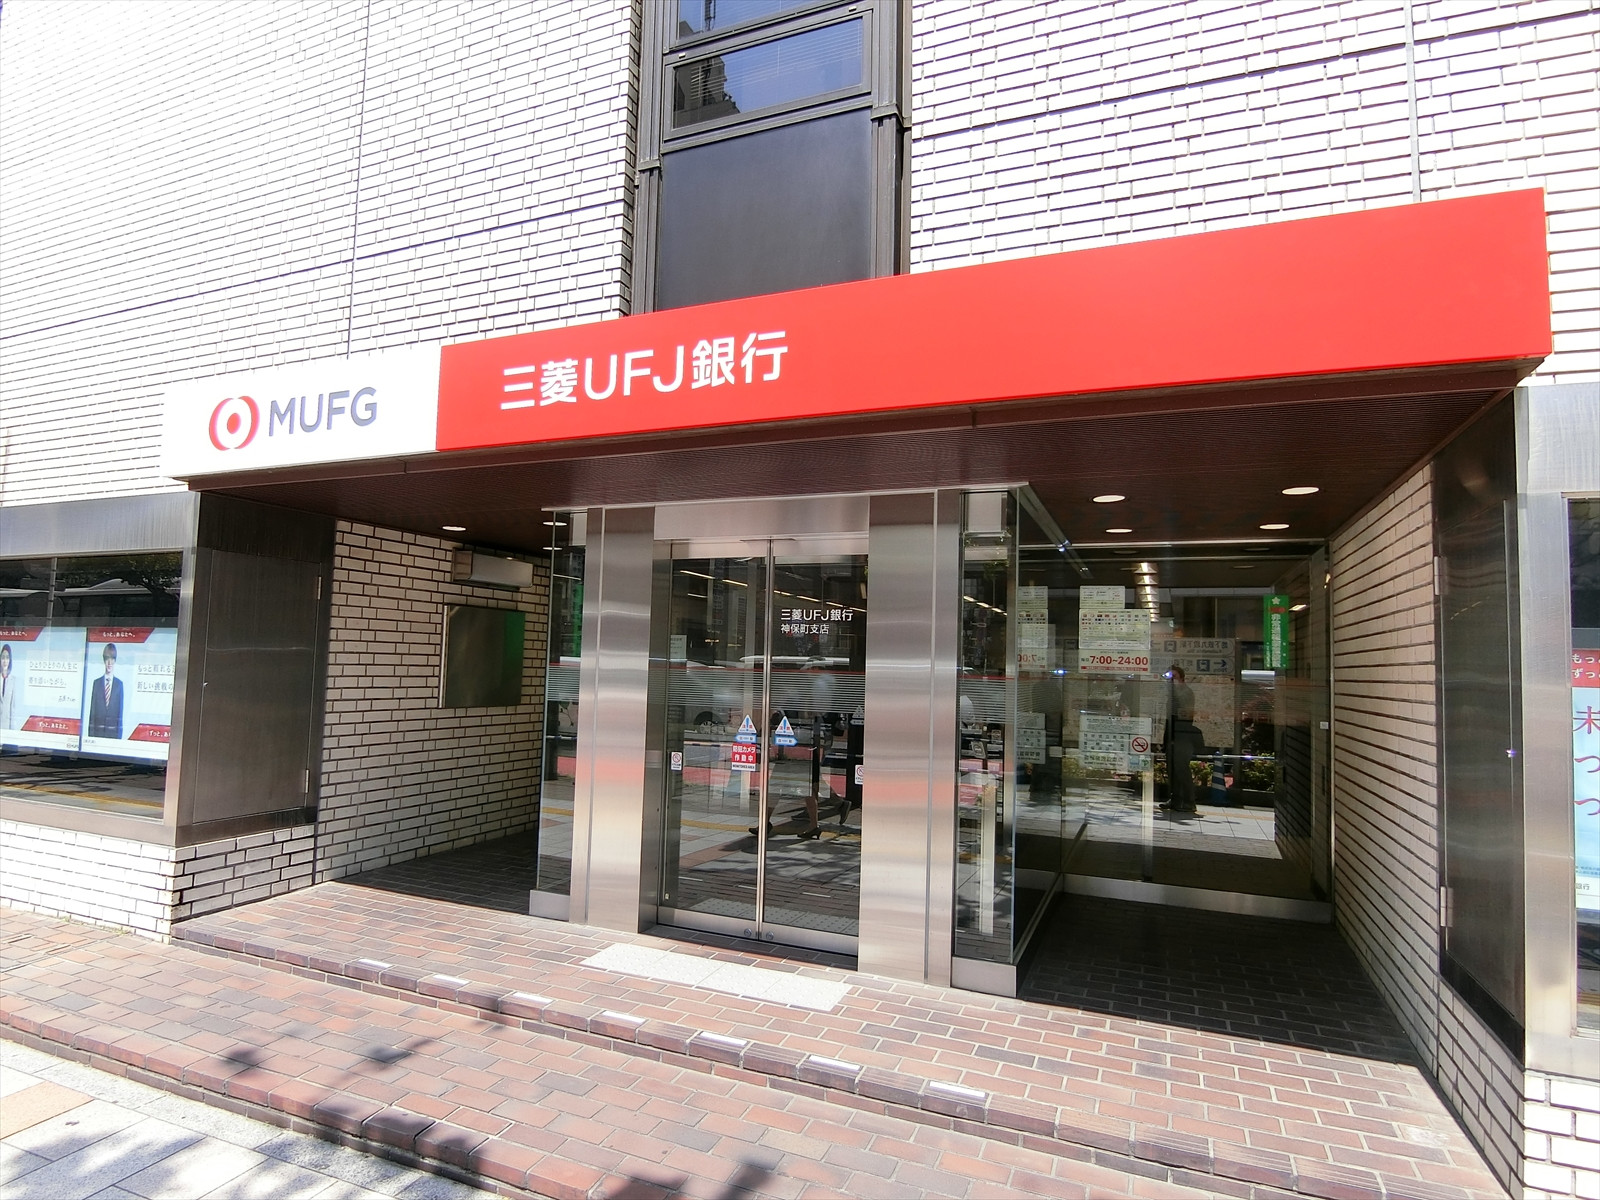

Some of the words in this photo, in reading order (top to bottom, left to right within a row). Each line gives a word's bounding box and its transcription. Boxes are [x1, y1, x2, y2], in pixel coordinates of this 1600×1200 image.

[500, 330, 788, 412] 三菱UFJ銀行
[269, 386, 377, 437] MUFG
[780, 608, 853, 622] 三菱UFJ銀行
[780, 623, 830, 635] 神保町支店
[1572, 653, 1600, 664] もっ
[1572, 668, 1600, 679] ずっ
